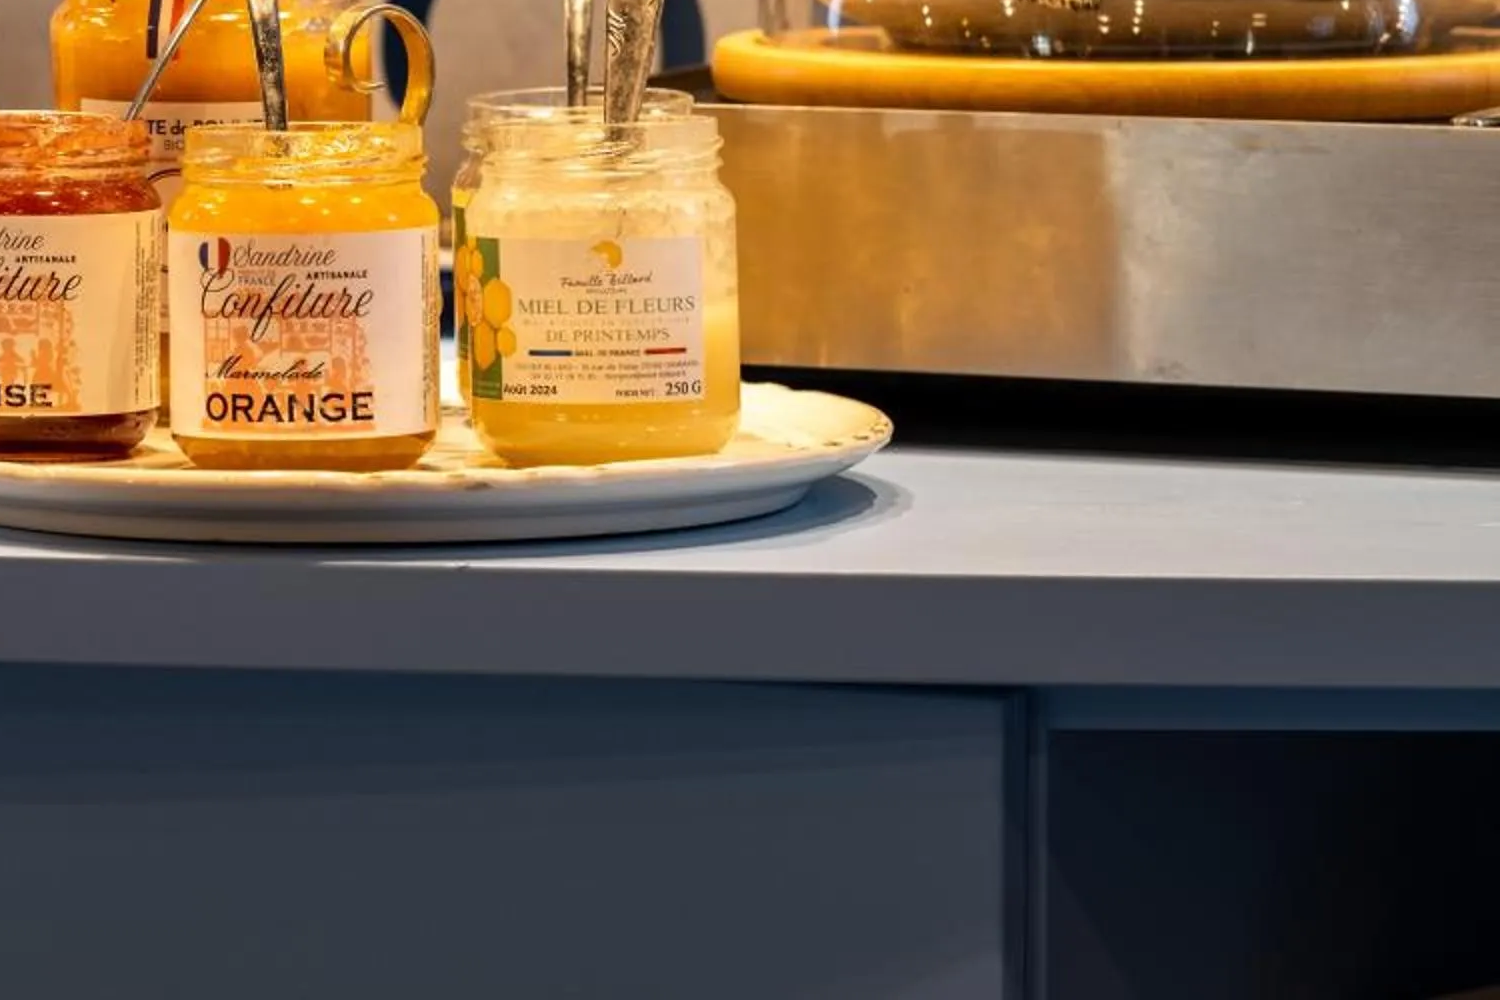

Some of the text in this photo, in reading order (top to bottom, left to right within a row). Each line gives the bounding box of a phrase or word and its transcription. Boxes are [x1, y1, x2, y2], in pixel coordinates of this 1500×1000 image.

[15, 255, 77, 264] ARTISANALE
[233, 239, 337, 268] Sandrine
[306, 269, 368, 281] ARTISANALE
[200, 267, 374, 343] Confiture
[518, 296, 696, 315] MIEL DE FLEURS
[546, 327, 671, 343] DE PRINTEMPS
[205, 354, 325, 380] Marmelade
[503, 383, 557, 395] Août 2024
[665, 379, 701, 396] 250 G
[205, 391, 374, 423] ORANGE
